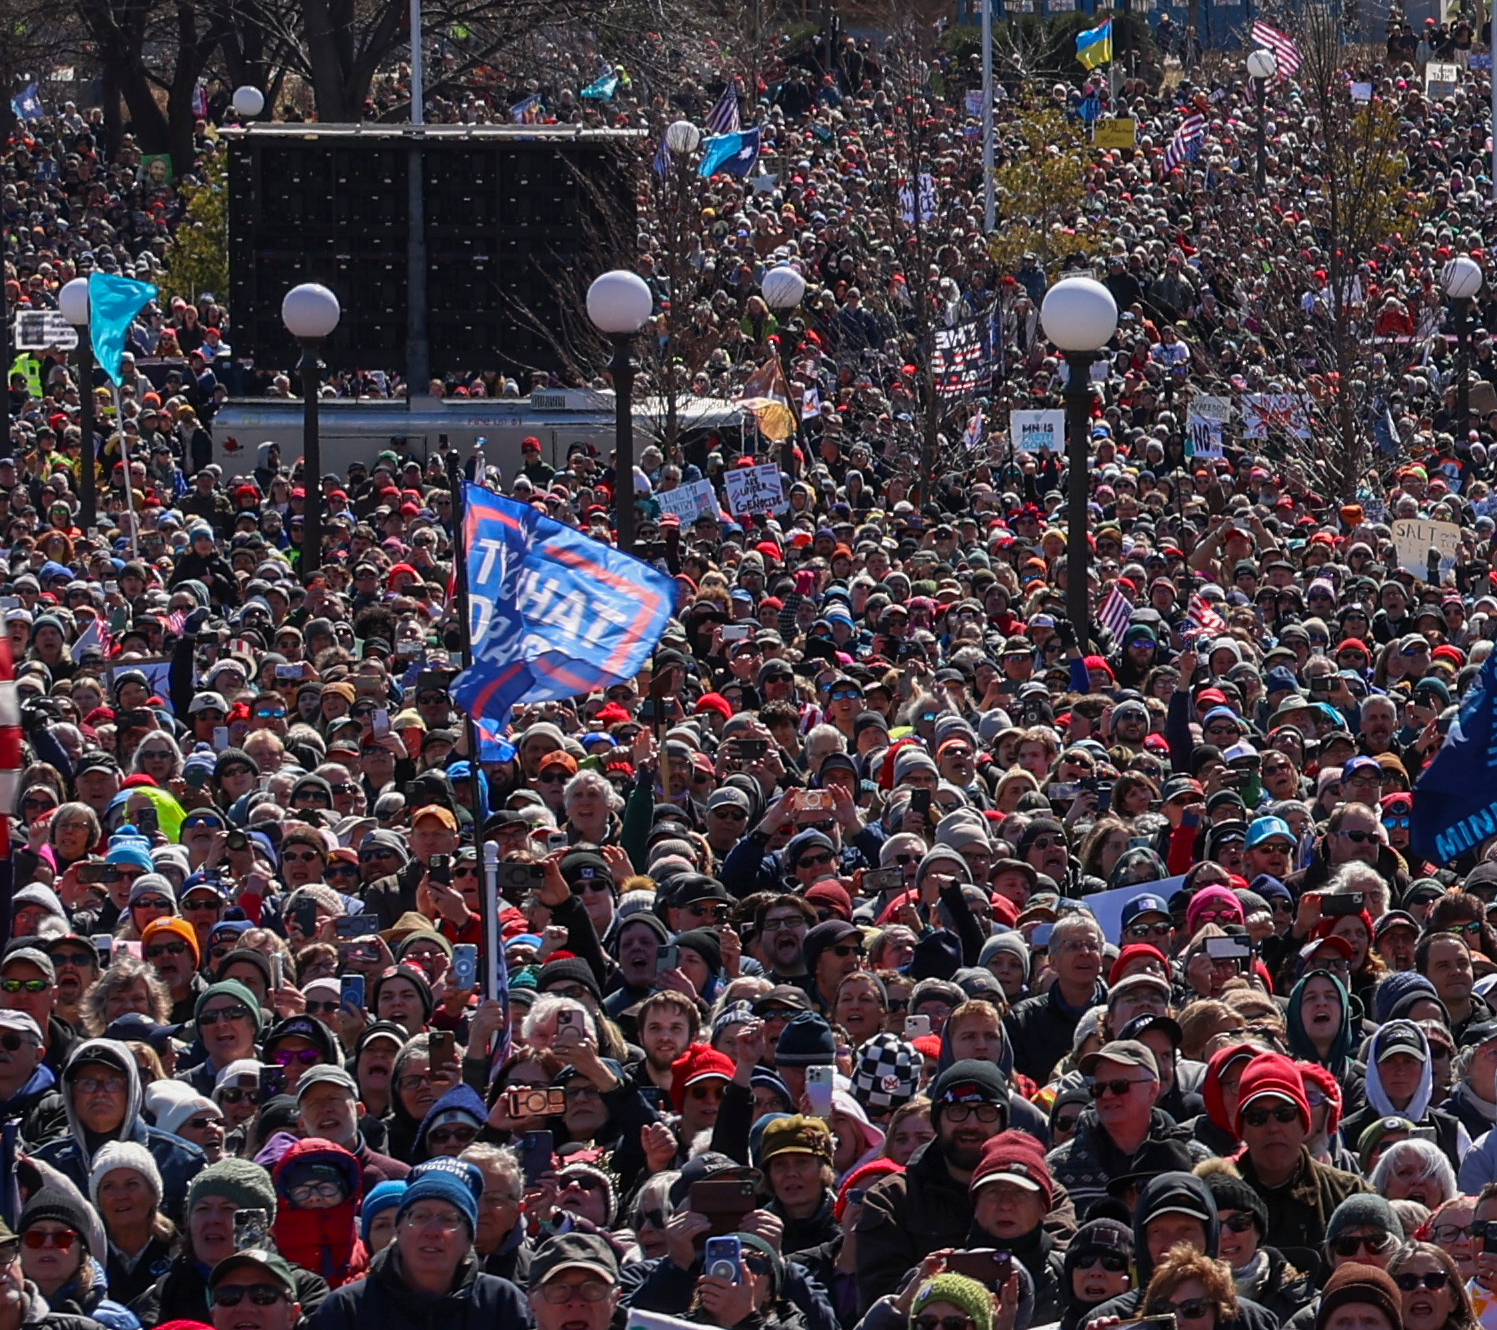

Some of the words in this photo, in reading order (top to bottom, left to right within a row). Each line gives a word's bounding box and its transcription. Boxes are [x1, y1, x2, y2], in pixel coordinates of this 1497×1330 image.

[1022, 423, 1038, 433] MN
[744, 470, 759, 480] WE
[745, 479, 760, 489] ARE
[735, 495, 783, 513] GENOCIDE
[1396, 523, 1435, 542] SALT
